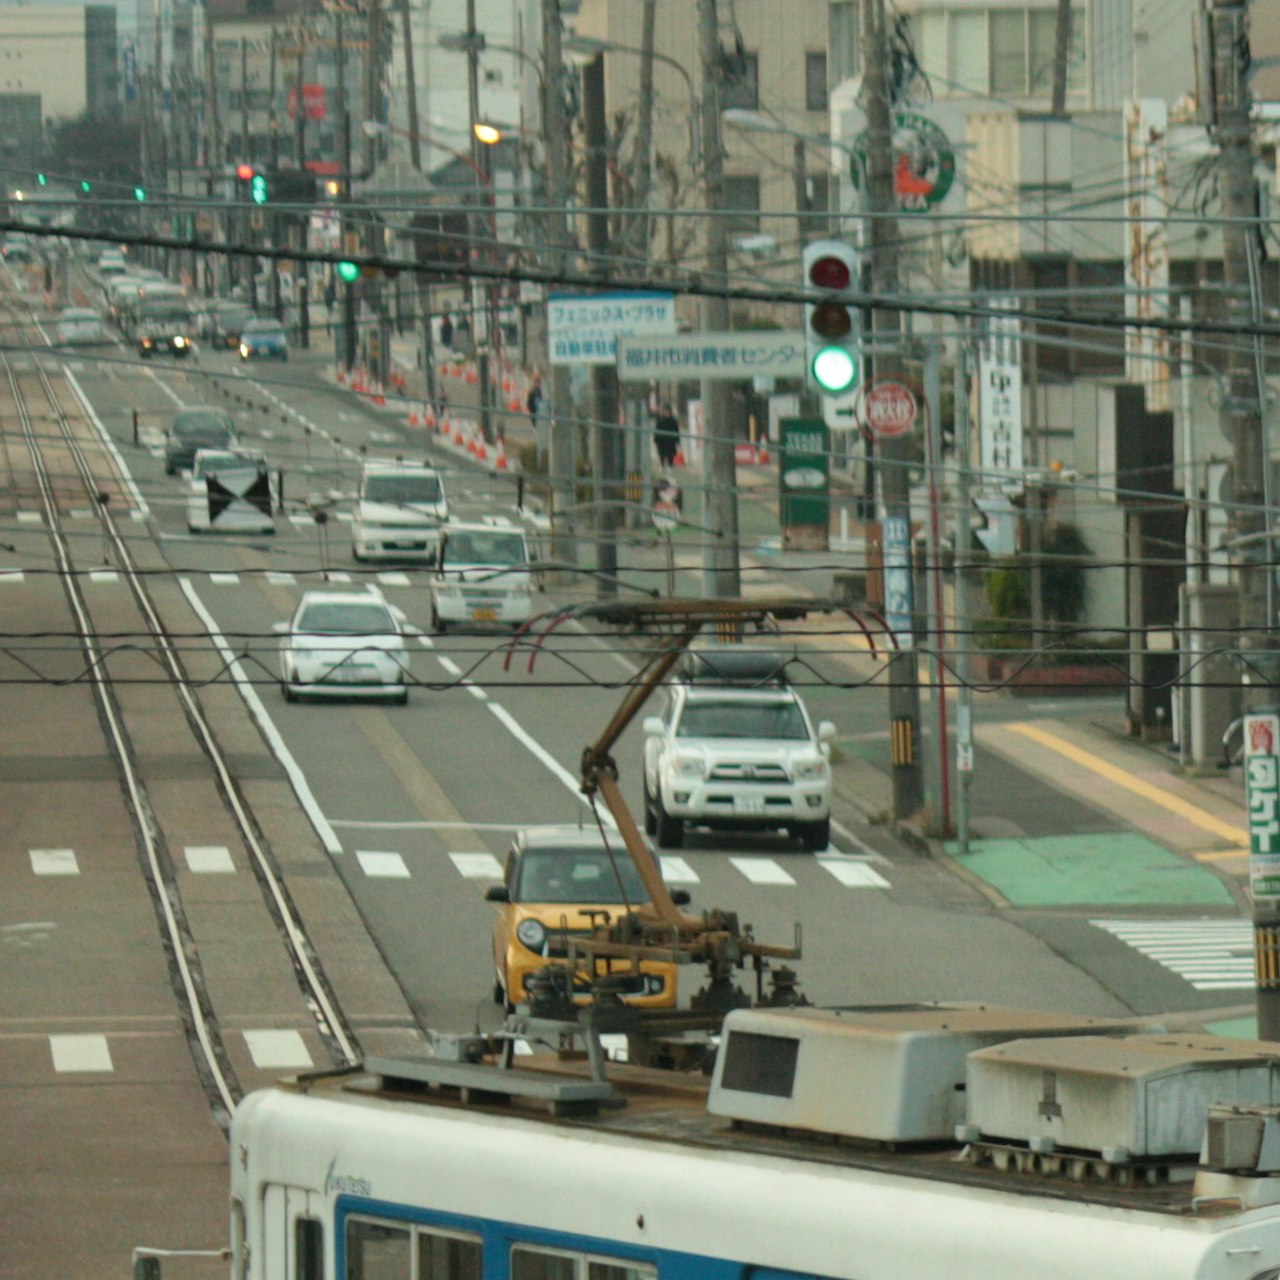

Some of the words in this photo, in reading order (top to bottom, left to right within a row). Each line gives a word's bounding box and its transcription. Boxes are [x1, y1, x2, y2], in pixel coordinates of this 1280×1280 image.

[553, 304, 667, 324] フェニックス・プラザ
